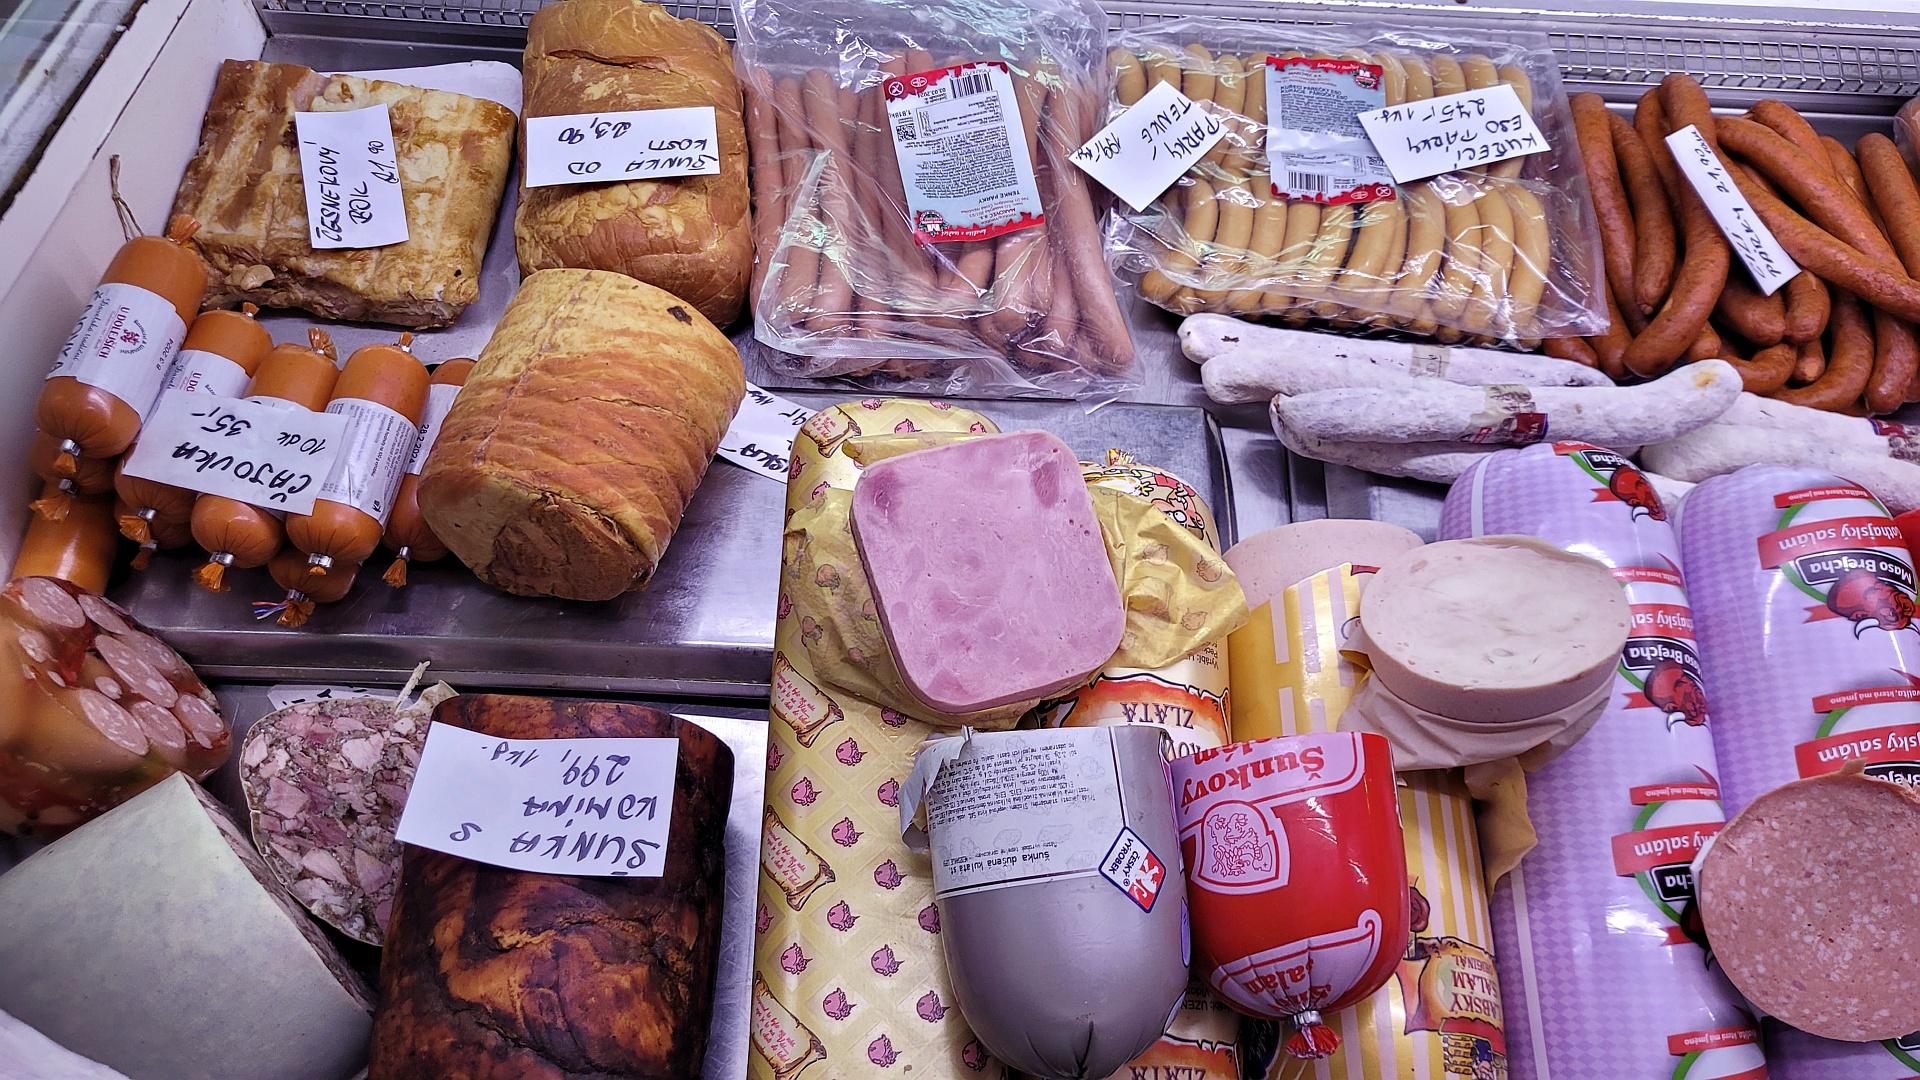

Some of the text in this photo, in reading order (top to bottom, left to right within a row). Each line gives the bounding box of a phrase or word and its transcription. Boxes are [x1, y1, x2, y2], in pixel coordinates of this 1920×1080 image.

[1406, 114, 1523, 154] ESO PÁRKY
[567, 154, 718, 176] ŠUNKA OD
[1454, 132, 1537, 170] KUŘECÍ
[98, 313, 128, 359] DOLEJŠÍCH
[171, 442, 312, 503] ČAJOVKA
[1778, 527, 1836, 551] salám
[1808, 556, 1913, 586] Maso Brejcha
[1628, 644, 1684, 665] Brejcha
[1829, 692, 1858, 706] jméno
[1120, 702, 1195, 730] ZLATÁ
[1817, 738, 1882, 763] salám
[1181, 745, 1326, 815] Šunkový
[448, 821, 661, 876] ŠUNKA S
[1022, 851, 1051, 864] šunka
[1108, 837, 1134, 875] VÝROBEK
[1633, 834, 1690, 857] salám
[959, 861, 984, 875] kulatá
[987, 856, 1017, 870] dušená
[1122, 850, 1141, 878] ČESKÝ
[1450, 970, 1498, 998] SALÁM
[1180, 1000, 1208, 1011] UZEN
